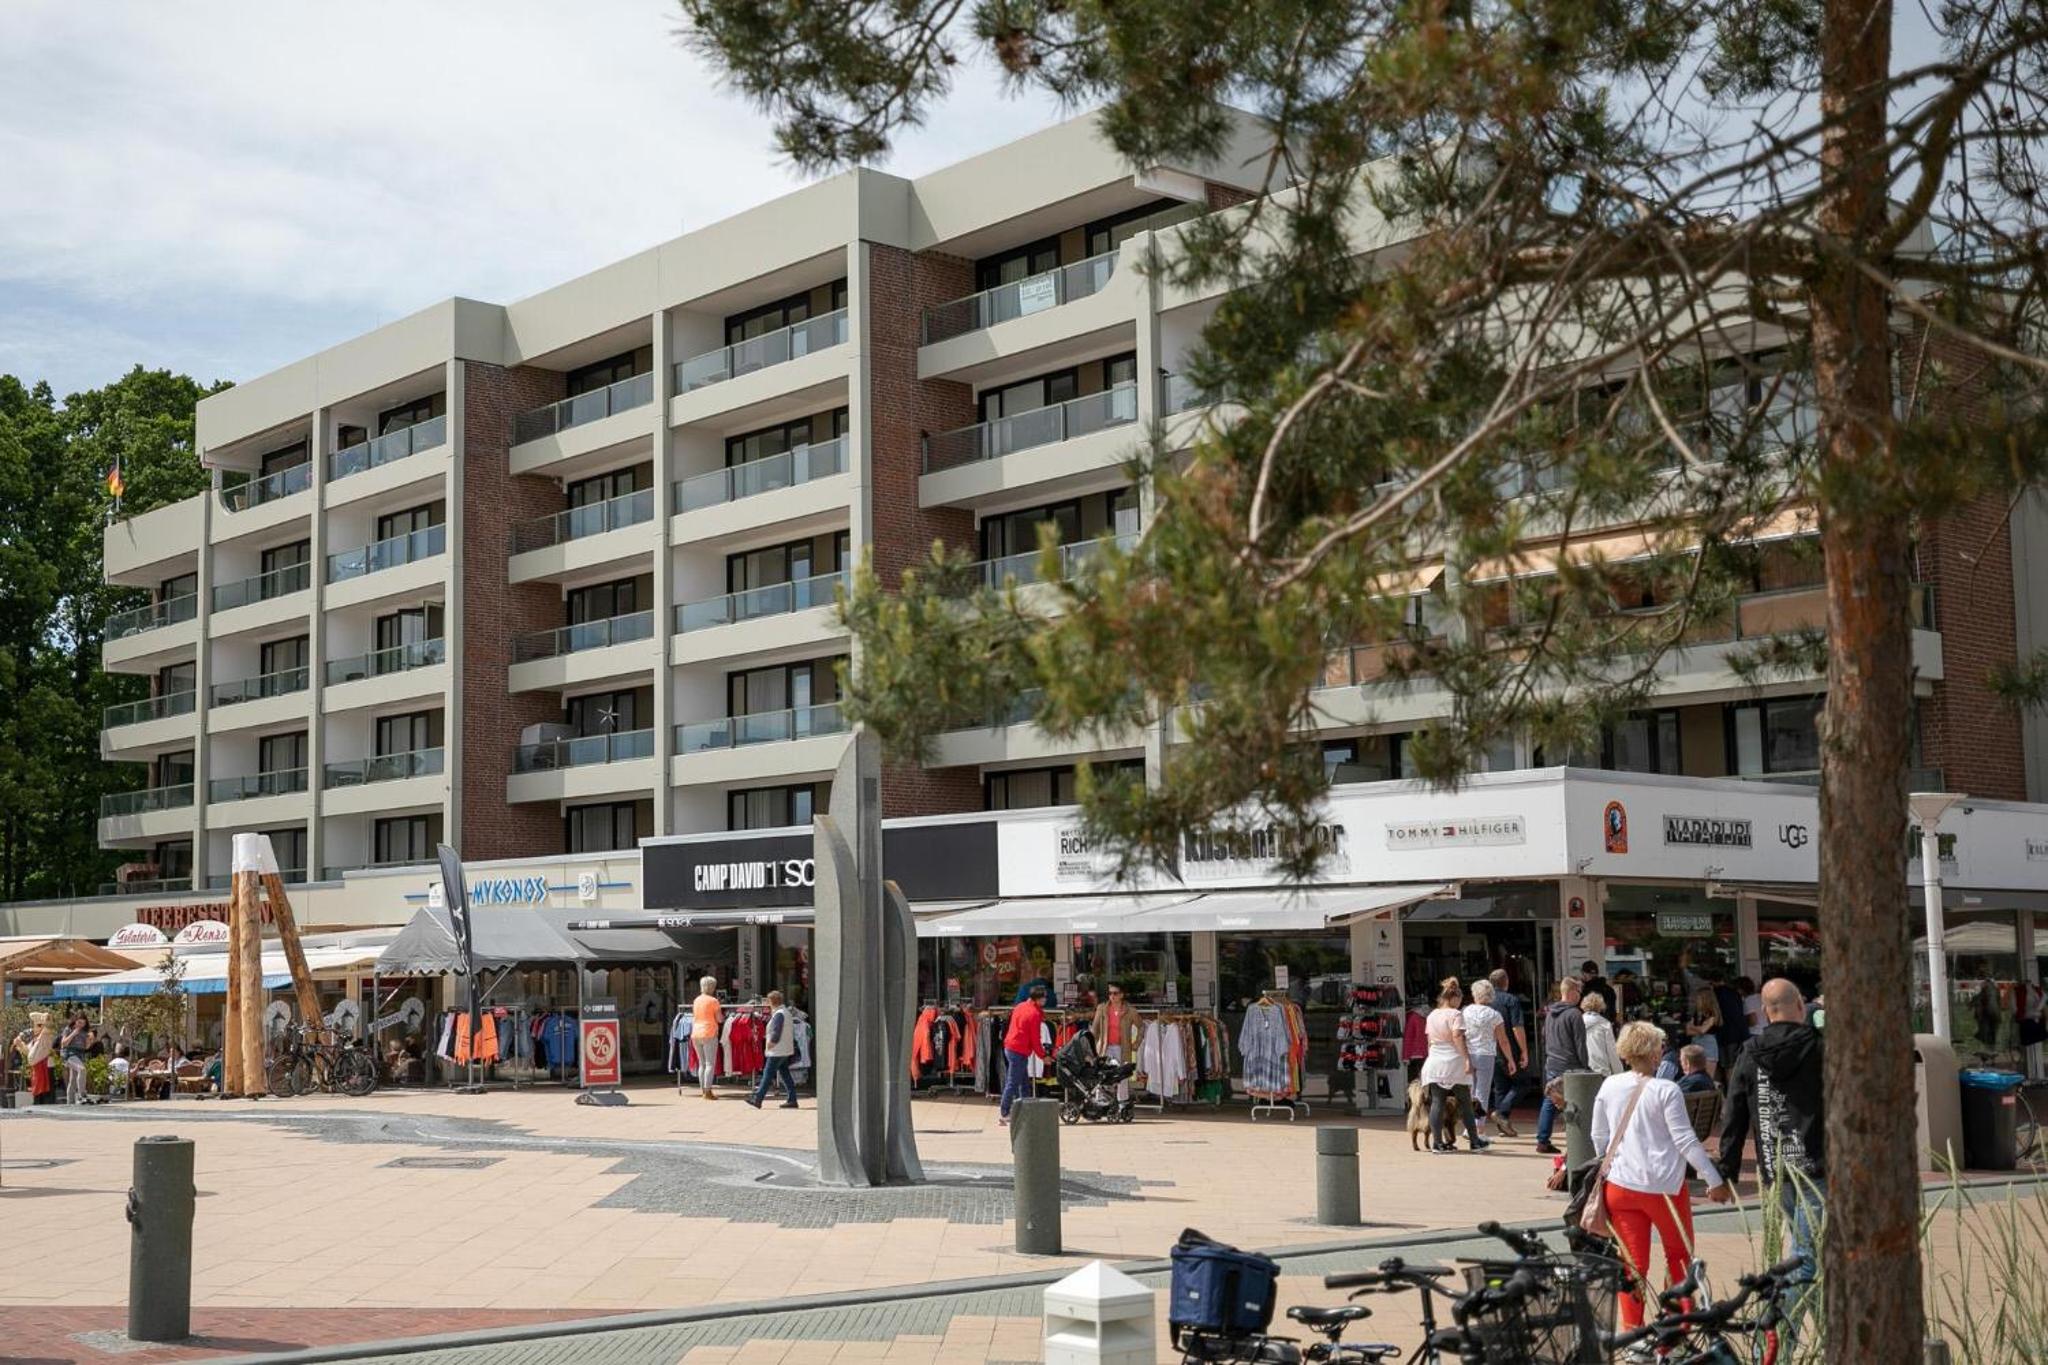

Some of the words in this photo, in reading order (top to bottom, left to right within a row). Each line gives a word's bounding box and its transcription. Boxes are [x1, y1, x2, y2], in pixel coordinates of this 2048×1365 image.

[1387, 828, 1438, 839] TOMMY
[1458, 822, 1519, 835] HILFIGER
[1778, 823, 1808, 849] UGG
[1060, 837, 1088, 854] RICH
[694, 864, 728, 892] CAMP
[729, 861, 766, 889] DAVID
[471, 876, 547, 905] MYKONOS
[1758, 1105, 1771, 1141] DAVID
